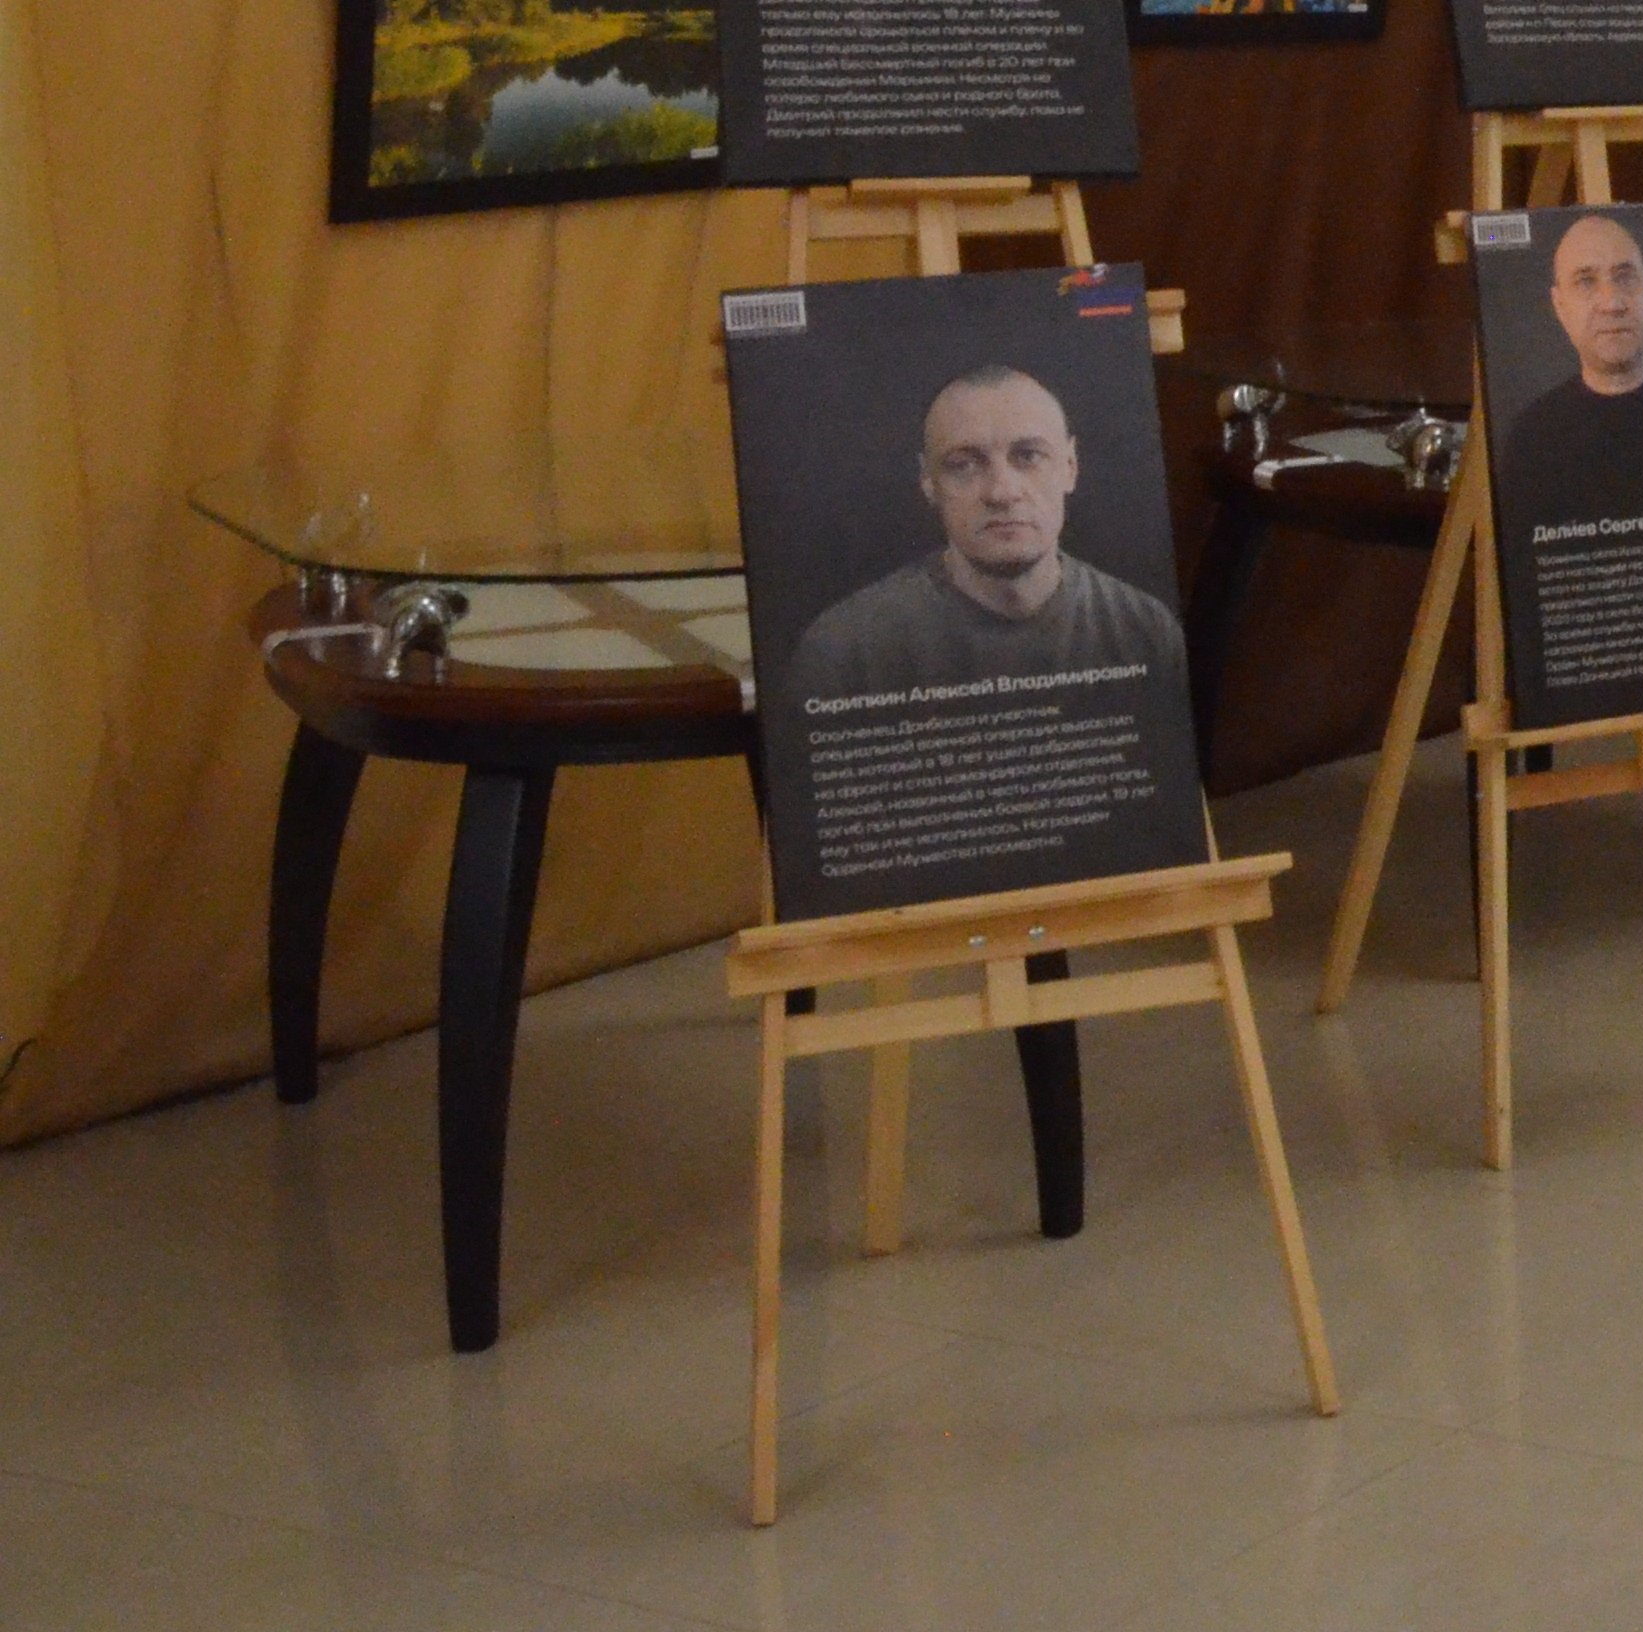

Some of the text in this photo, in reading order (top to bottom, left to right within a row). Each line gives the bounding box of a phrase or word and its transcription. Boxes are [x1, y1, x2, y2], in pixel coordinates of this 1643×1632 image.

[804, 665, 1147, 714] Скрипкин Алексей Владимирович
